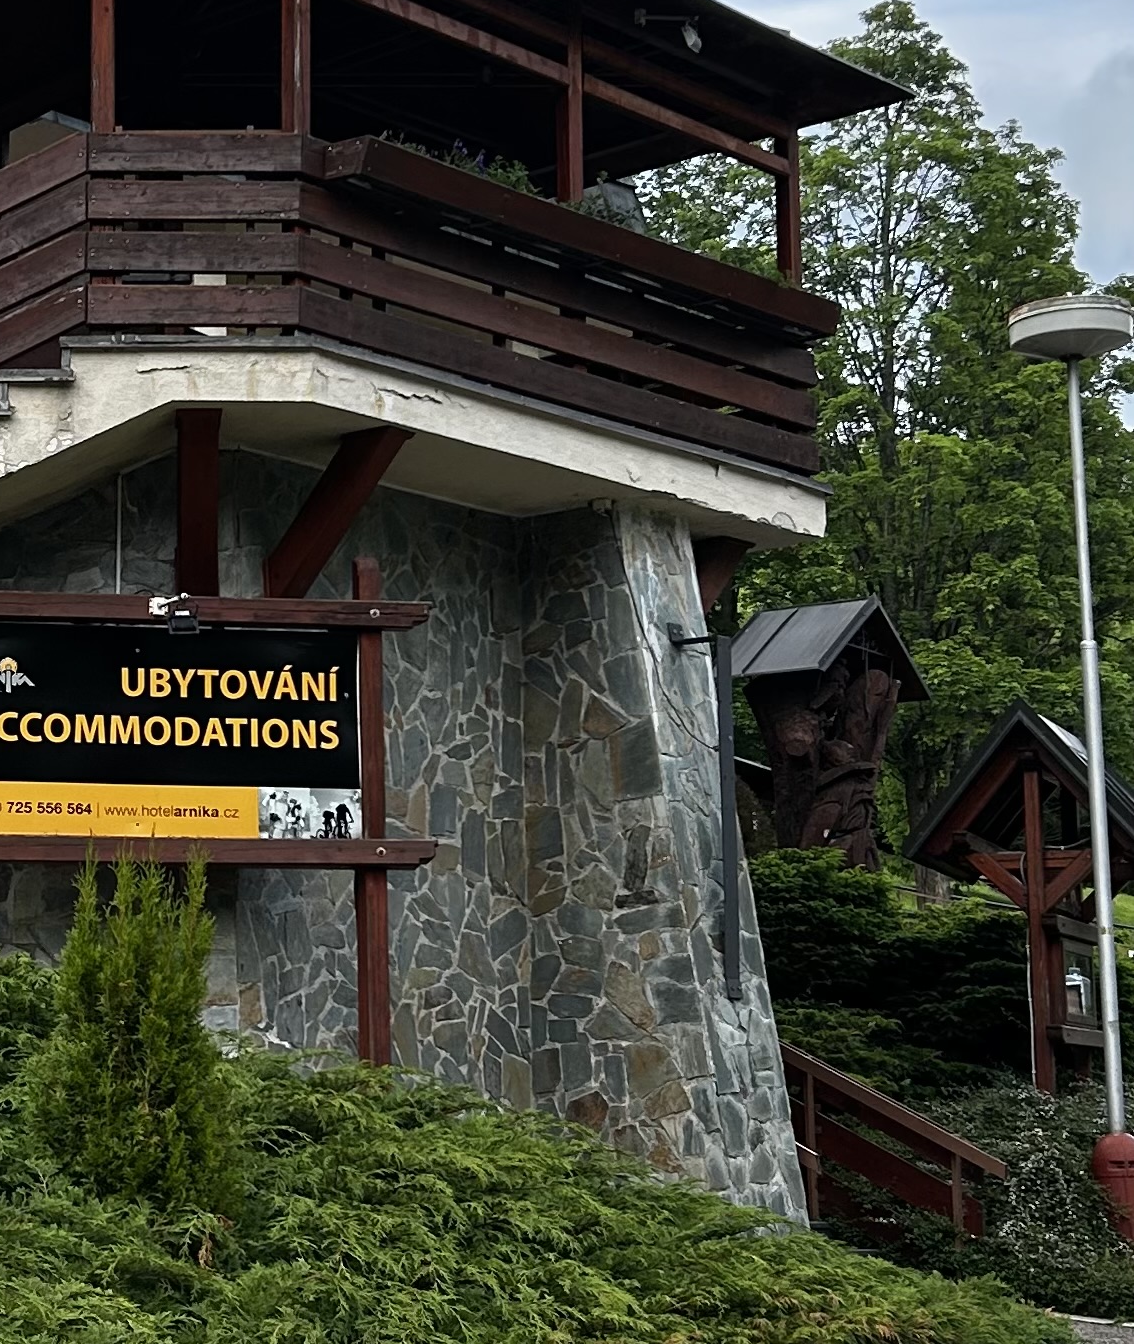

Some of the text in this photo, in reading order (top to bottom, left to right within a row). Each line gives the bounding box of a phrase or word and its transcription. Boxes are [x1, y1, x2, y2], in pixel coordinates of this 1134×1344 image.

[120, 663, 341, 702] UBYTOVÁNÍ
[6, 801, 33, 814] 725
[37, 802, 63, 814] 556
[67, 802, 93, 815] 564
[104, 805, 240, 818] www.hotelarnika.cz
